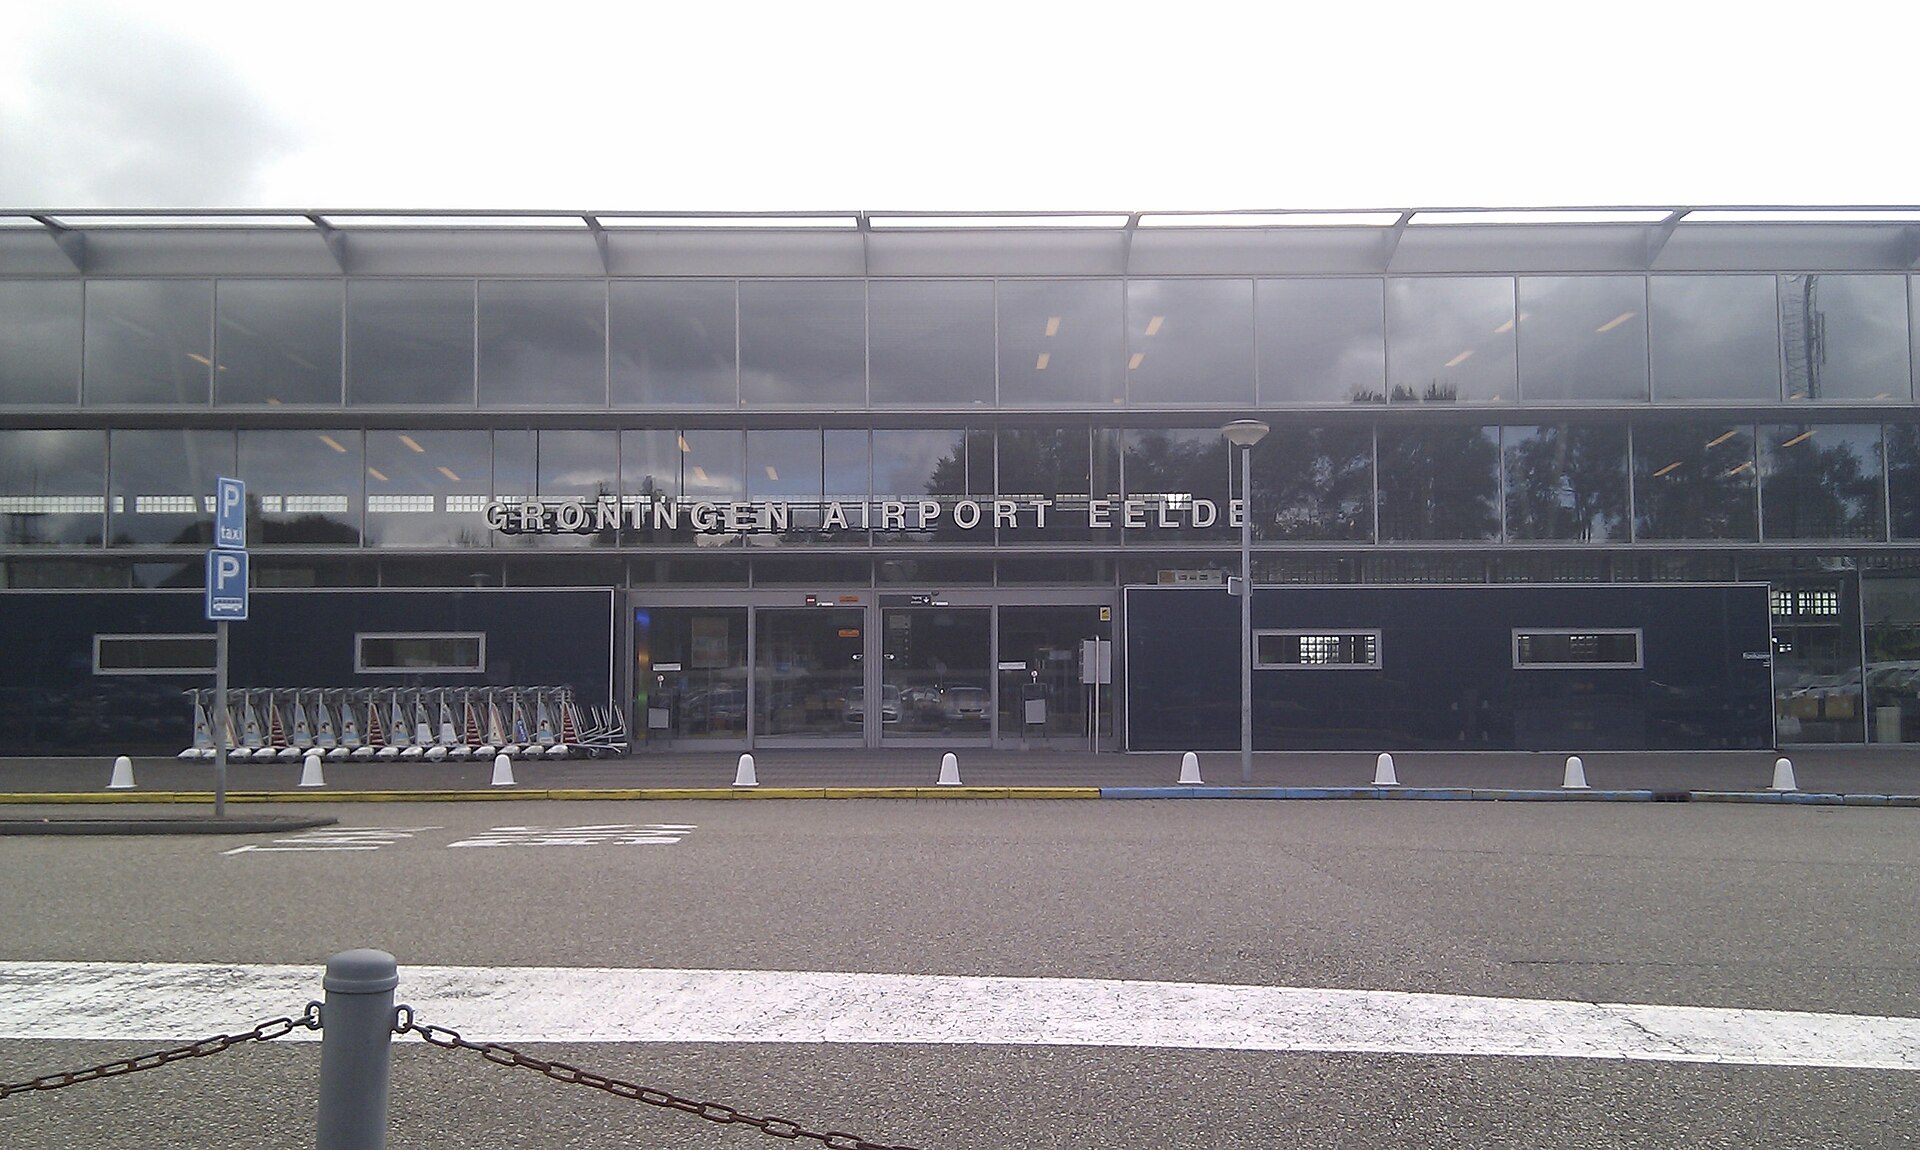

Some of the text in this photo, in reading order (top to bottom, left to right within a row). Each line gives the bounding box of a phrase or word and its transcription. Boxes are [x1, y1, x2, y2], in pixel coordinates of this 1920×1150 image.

[223, 484, 240, 518] P
[483, 499, 1243, 531] GRONINGEN AIRPORT EELDE
[221, 525, 243, 541] taxi
[217, 555, 240, 590] P
